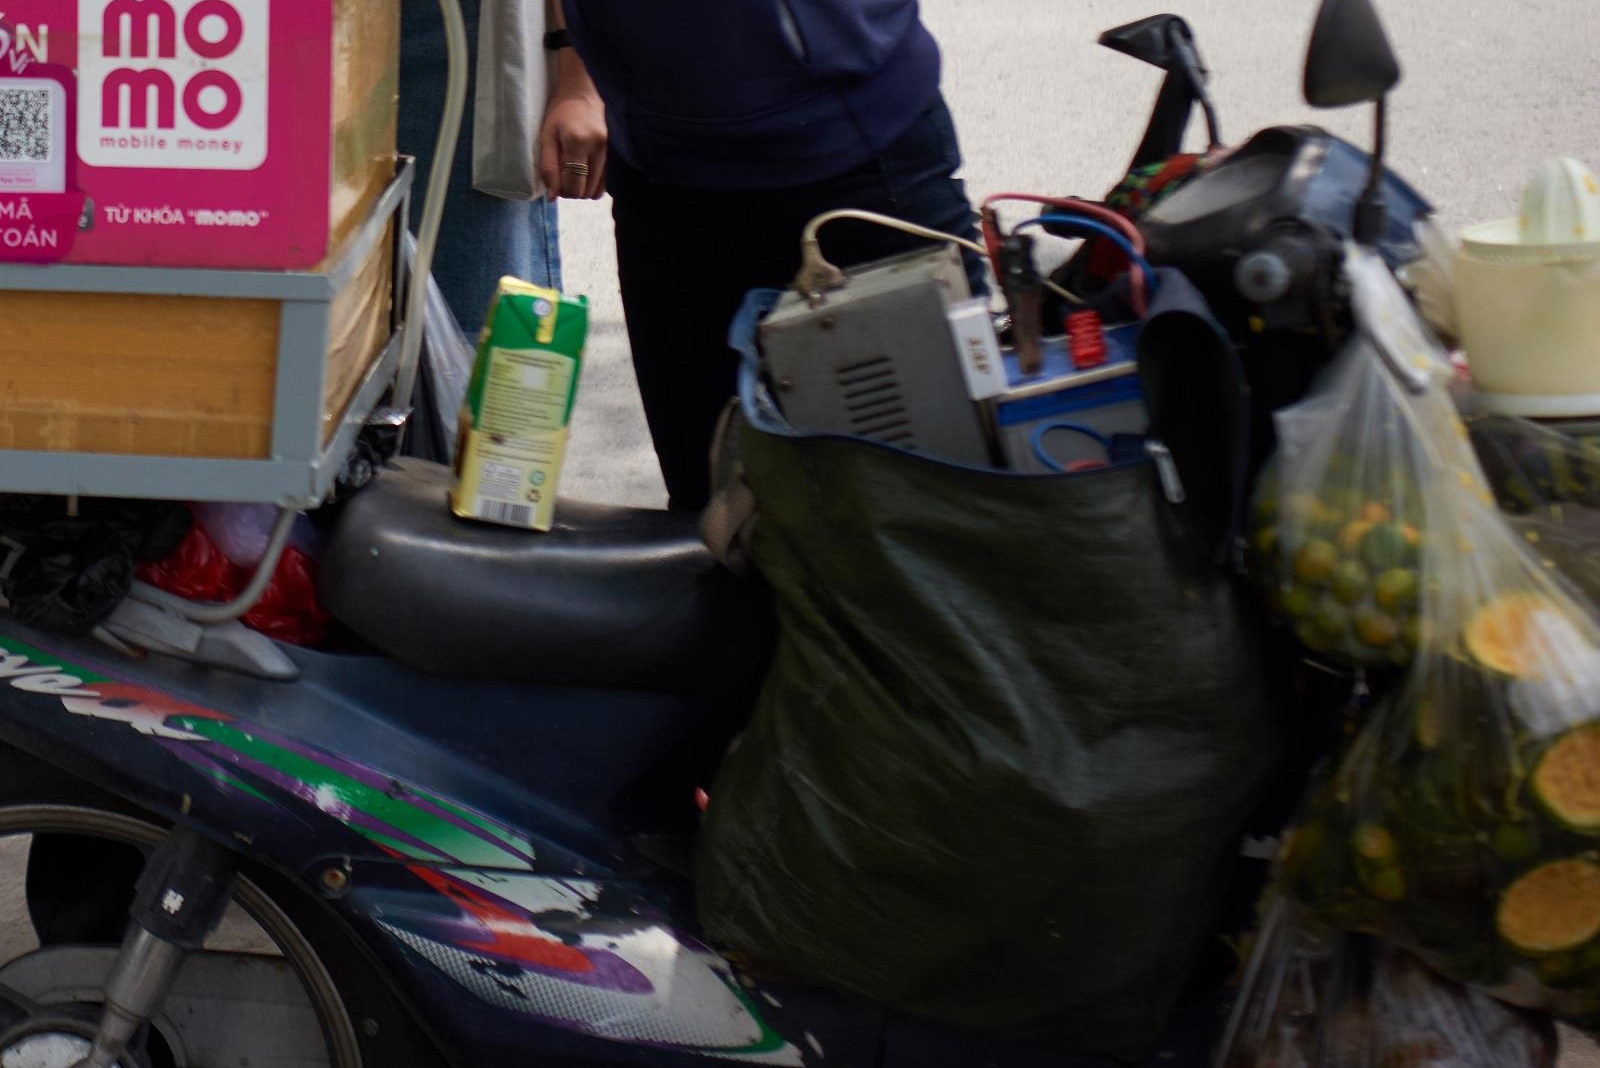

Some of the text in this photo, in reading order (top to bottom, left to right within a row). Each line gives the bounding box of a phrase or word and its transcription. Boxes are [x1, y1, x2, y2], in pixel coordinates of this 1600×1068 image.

[100, 135, 244, 154] mobile money
[133, 205, 185, 225] KHÓA
